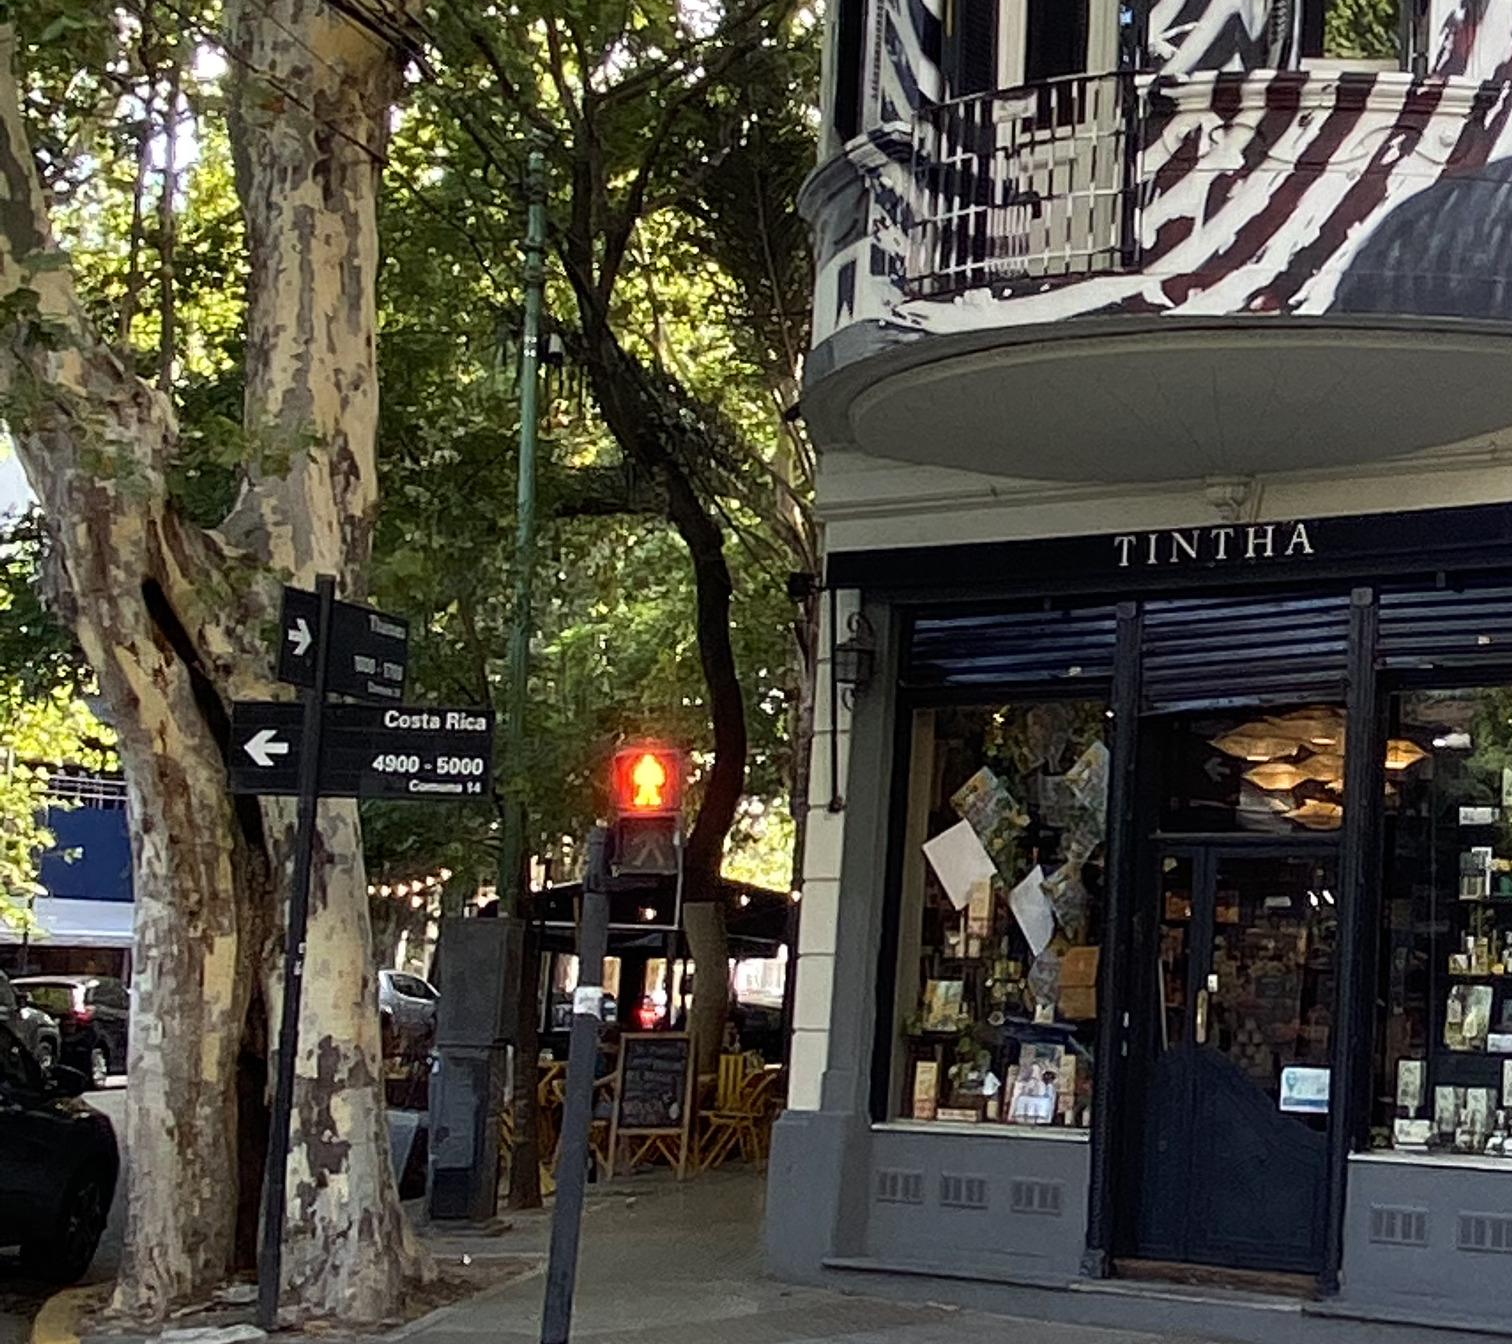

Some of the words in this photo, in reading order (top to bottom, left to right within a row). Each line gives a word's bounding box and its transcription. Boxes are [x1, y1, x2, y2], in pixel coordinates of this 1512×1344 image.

[1113, 522, 1315, 567] TINTHA
[384, 709, 441, 730] Costa
[445, 711, 487, 731] Rica
[371, 754, 421, 773] 4900
[436, 756, 485, 775] 5000
